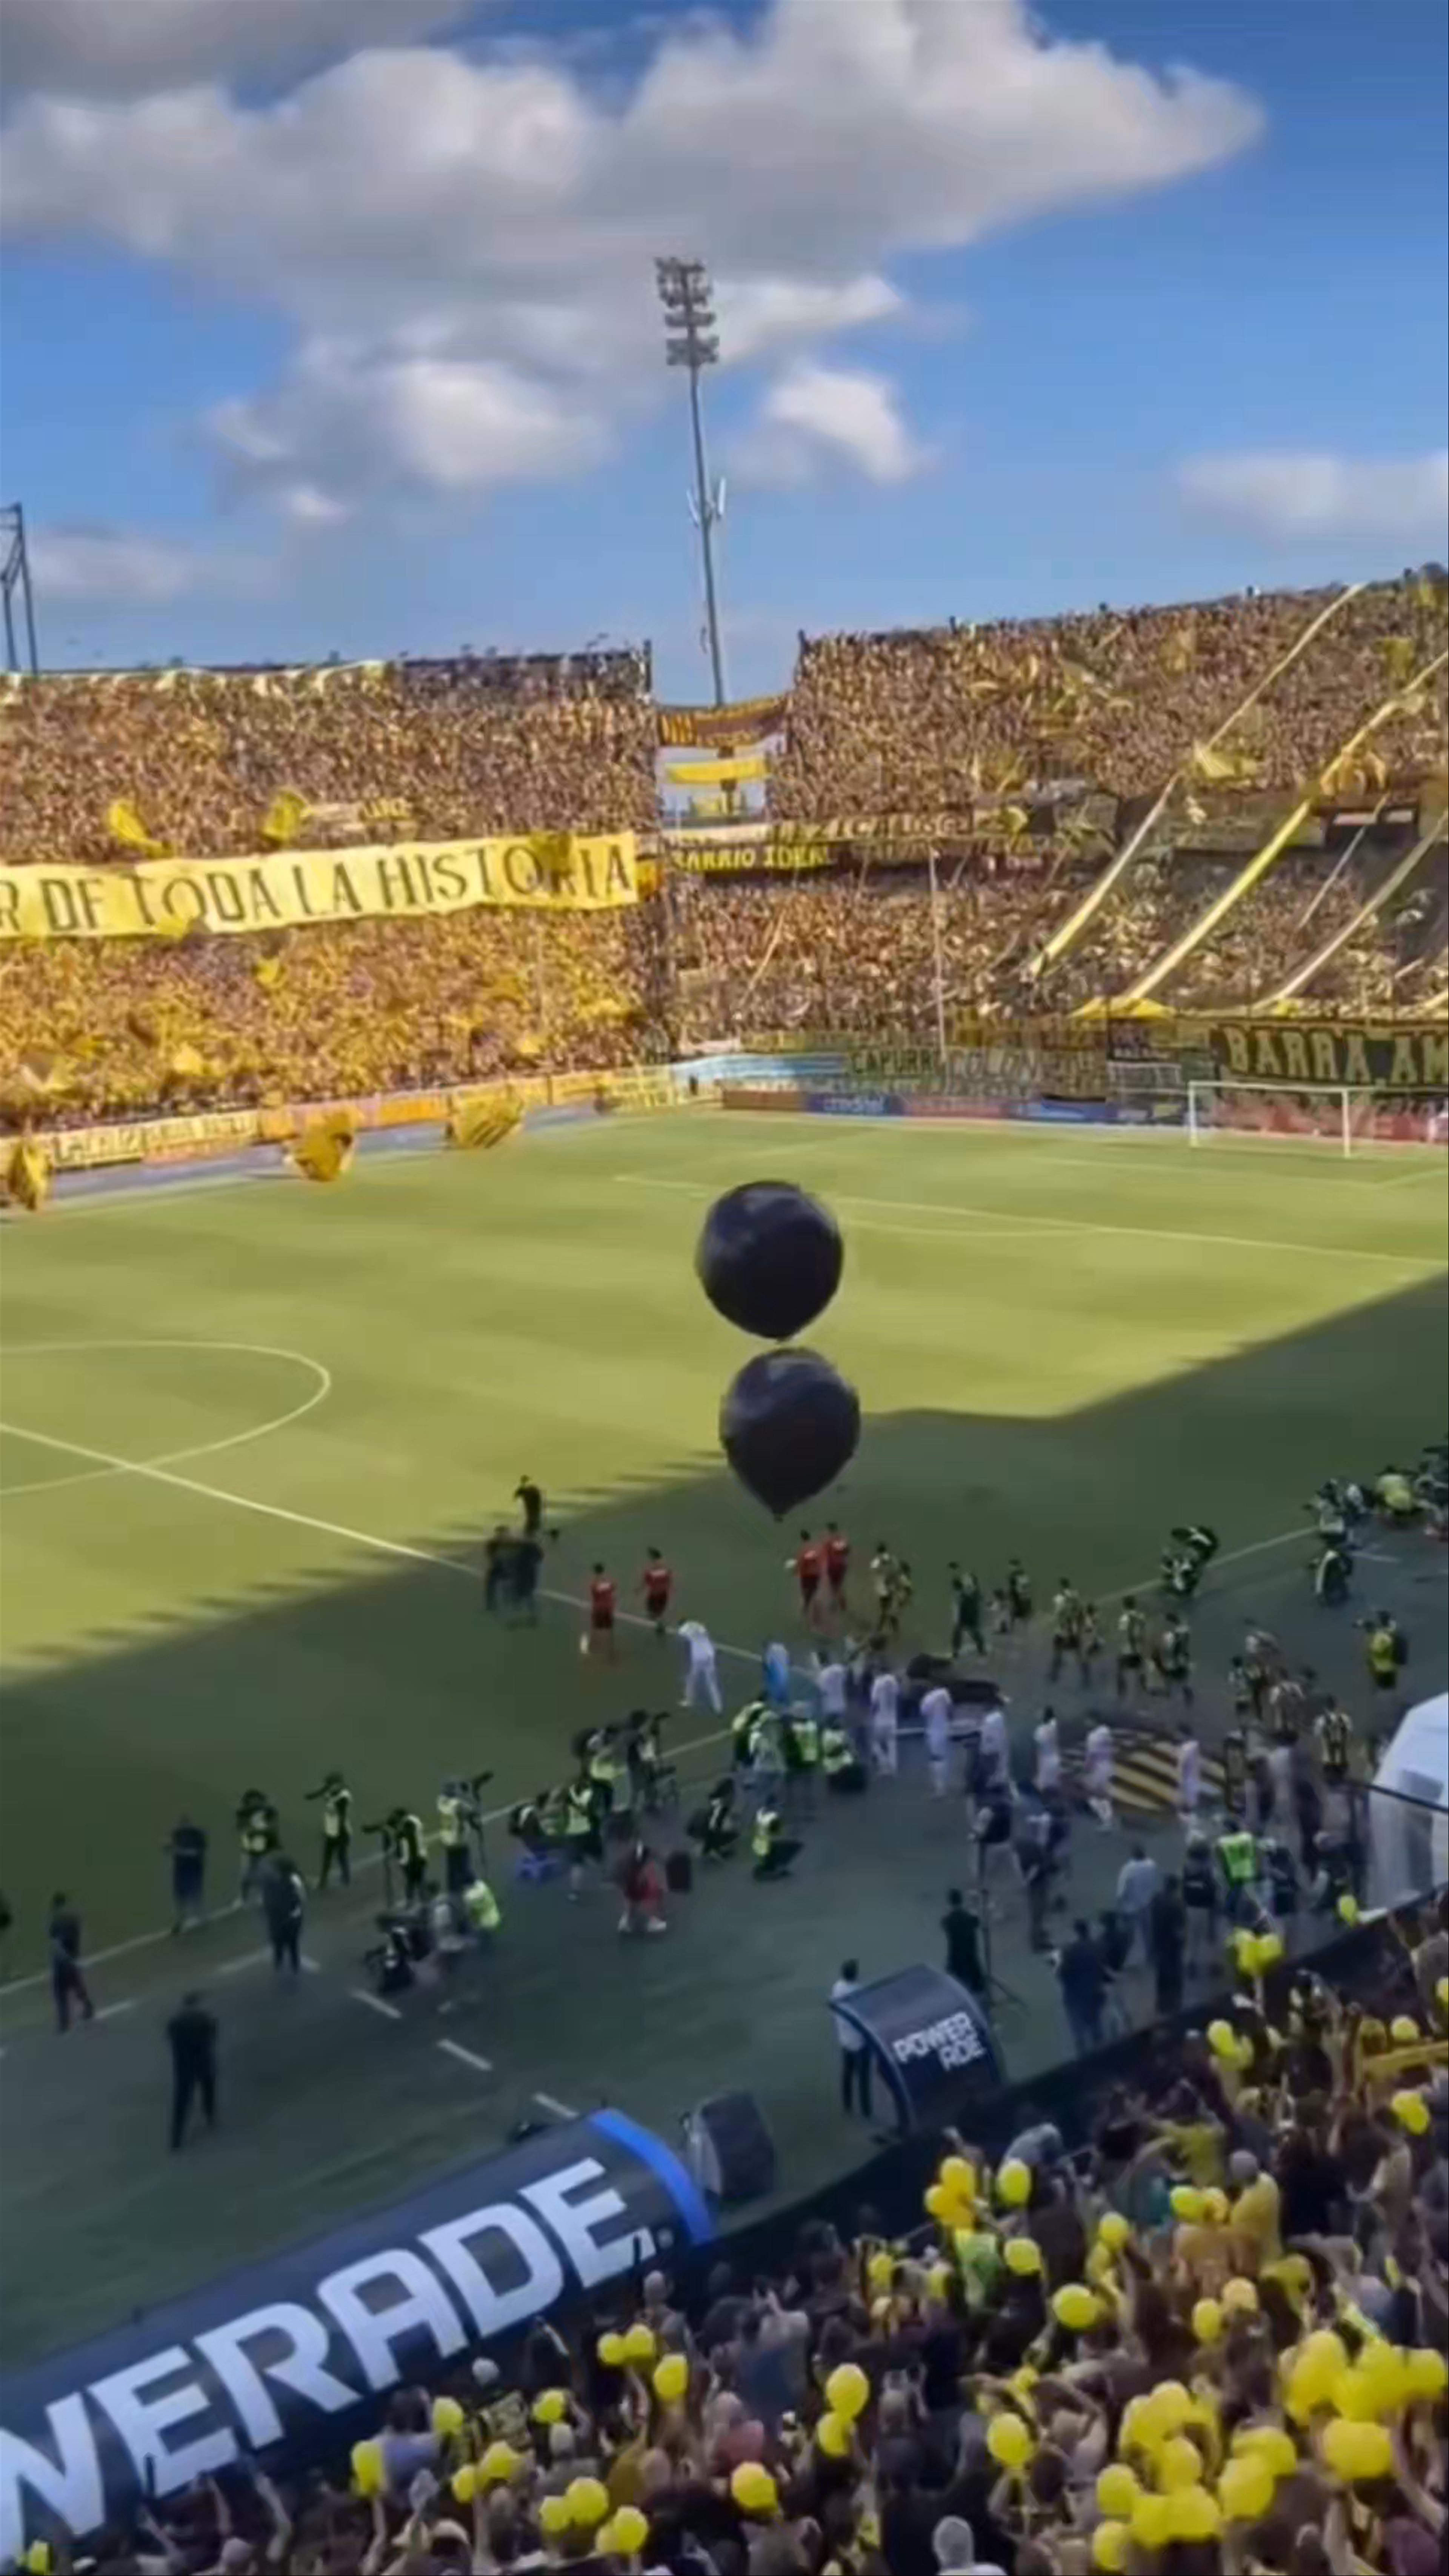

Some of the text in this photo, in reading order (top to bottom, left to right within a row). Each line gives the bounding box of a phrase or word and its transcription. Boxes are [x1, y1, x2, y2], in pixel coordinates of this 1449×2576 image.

[118, 868, 281, 926] TODA
[292, 862, 363, 915] LA
[1222, 1026, 1371, 1084] BARRA
